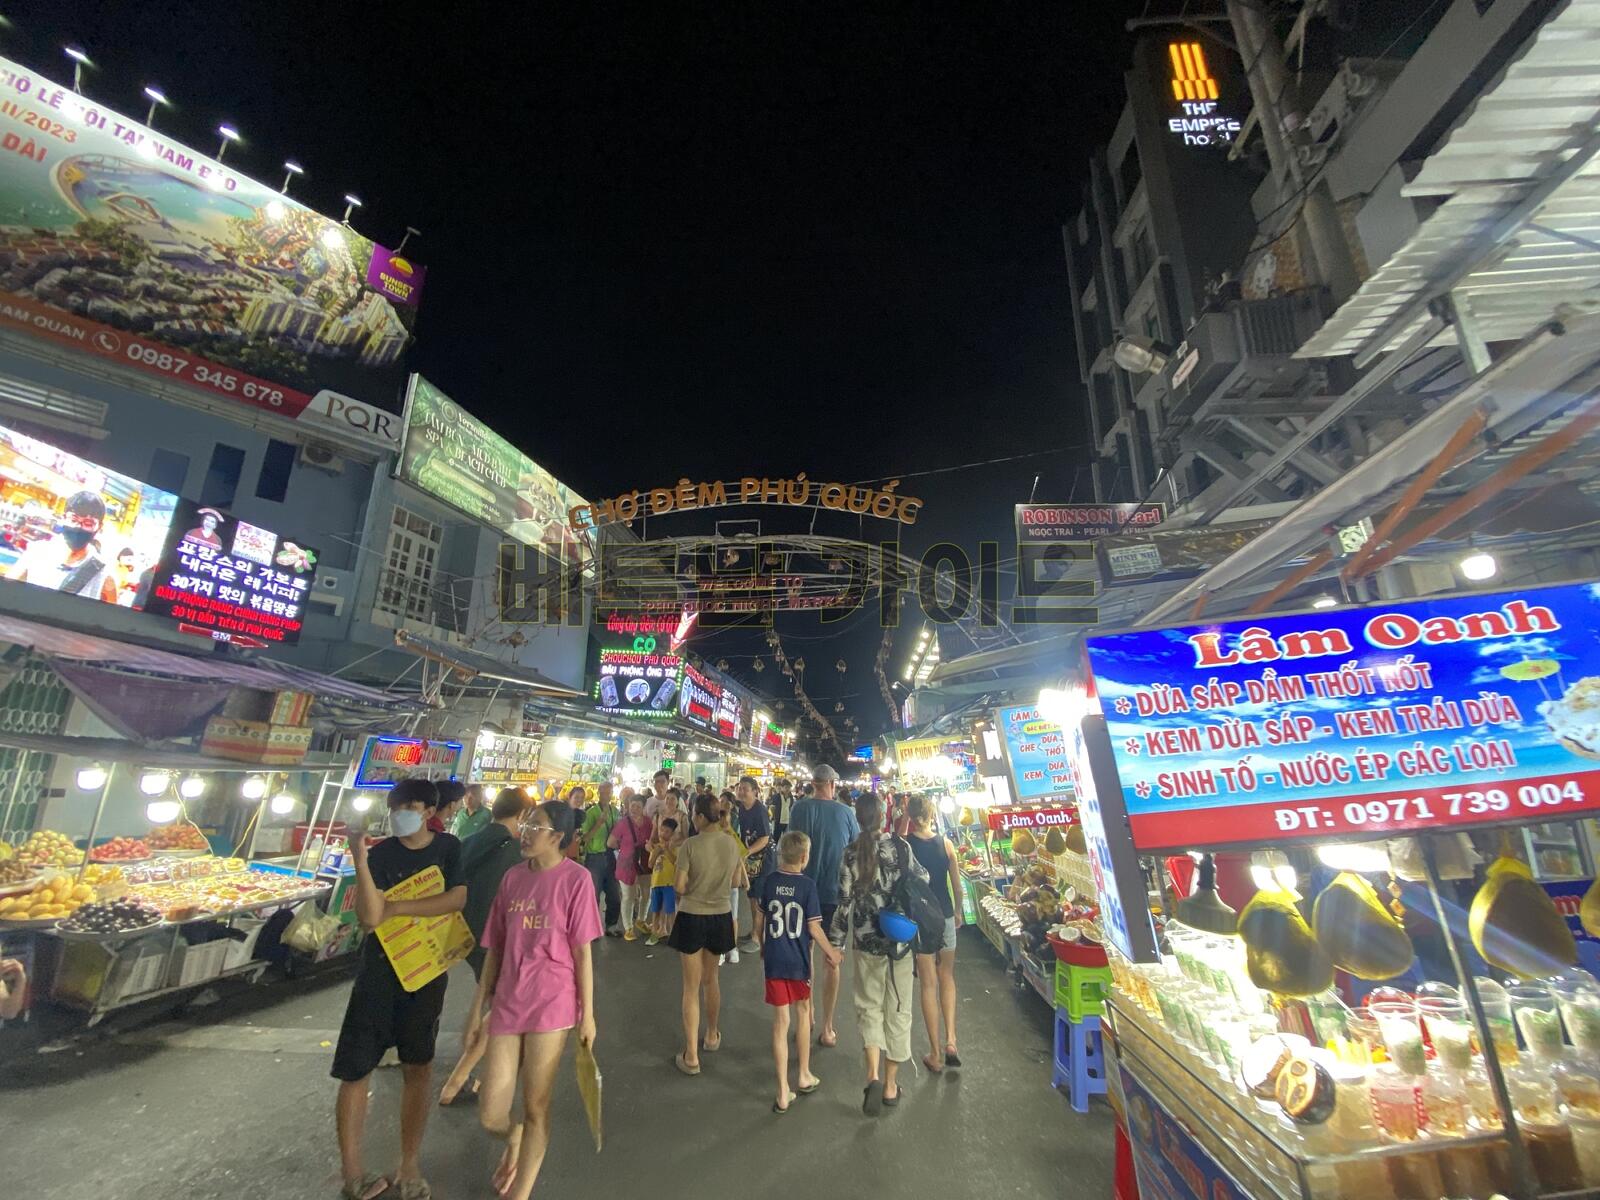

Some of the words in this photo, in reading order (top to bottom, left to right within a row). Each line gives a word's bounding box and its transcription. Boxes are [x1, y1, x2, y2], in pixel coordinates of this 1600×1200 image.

[72, 101, 107, 129] ỘI
[1184, 132, 1230, 145] hol
[380, 272, 414, 293] SUNSET
[33, 314, 86, 342] QUAN
[126, 343, 189, 376] 0987
[192, 364, 238, 393] 345
[241, 381, 285, 408] 678
[325, 396, 395, 441] PQR
[568, 490, 639, 531] CHỢ
[650, 478, 728, 514] ĐÊM
[740, 471, 811, 505] PHÚ
[820, 479, 924, 525] QUỐC
[1022, 508, 1112, 525] ROBINSON
[1116, 507, 1161, 525] Pearl
[1028, 527, 1053, 538] NGỌC
[1054, 527, 1073, 537] TRAI
[176, 540, 253, 574] 프랑스의
[180, 555, 237, 583] 내려온
[170, 574, 214, 597] 30가지
[218, 585, 246, 605] 맛의
[700, 577, 777, 590] WELCOME
[781, 576, 805, 590] TO
[731, 598, 781, 612] NIGHT
[1190, 626, 1354, 669] Lâm
[1365, 599, 1562, 650] Oanh
[1135, 681, 1189, 717] DỪA
[1190, 677, 1242, 711] SÁP
[1244, 667, 1308, 707] DẦM
[1307, 659, 1377, 700] THỐT
[1144, 726, 1203, 757] KEM
[1205, 717, 1262, 751] DỪA
[1263, 712, 1315, 746] SÁP
[1334, 708, 1397, 740] KEM
[1396, 695, 1464, 733] TRÁI
[1462, 691, 1523, 727] DỪA
[1024, 770, 1043, 781] KEM
[1156, 766, 1217, 800] SINH
[1219, 755, 1258, 793] TỐ
[1278, 749, 1351, 789] NƯỚC
[1355, 746, 1391, 782] ÉP
[1396, 742, 1452, 777] CÁC
[1450, 738, 1518, 774] LOẠI
[1002, 812, 1034, 829] Lâm
[1035, 811, 1072, 826] Oanh
[1274, 806, 1336, 832] ĐT:
[1342, 796, 1436, 826] 0971
[1441, 788, 1511, 817] 739
[1517, 780, 1586, 809] 004
[775, 885, 796, 897] MESSI
[768, 899, 804, 940] 30
